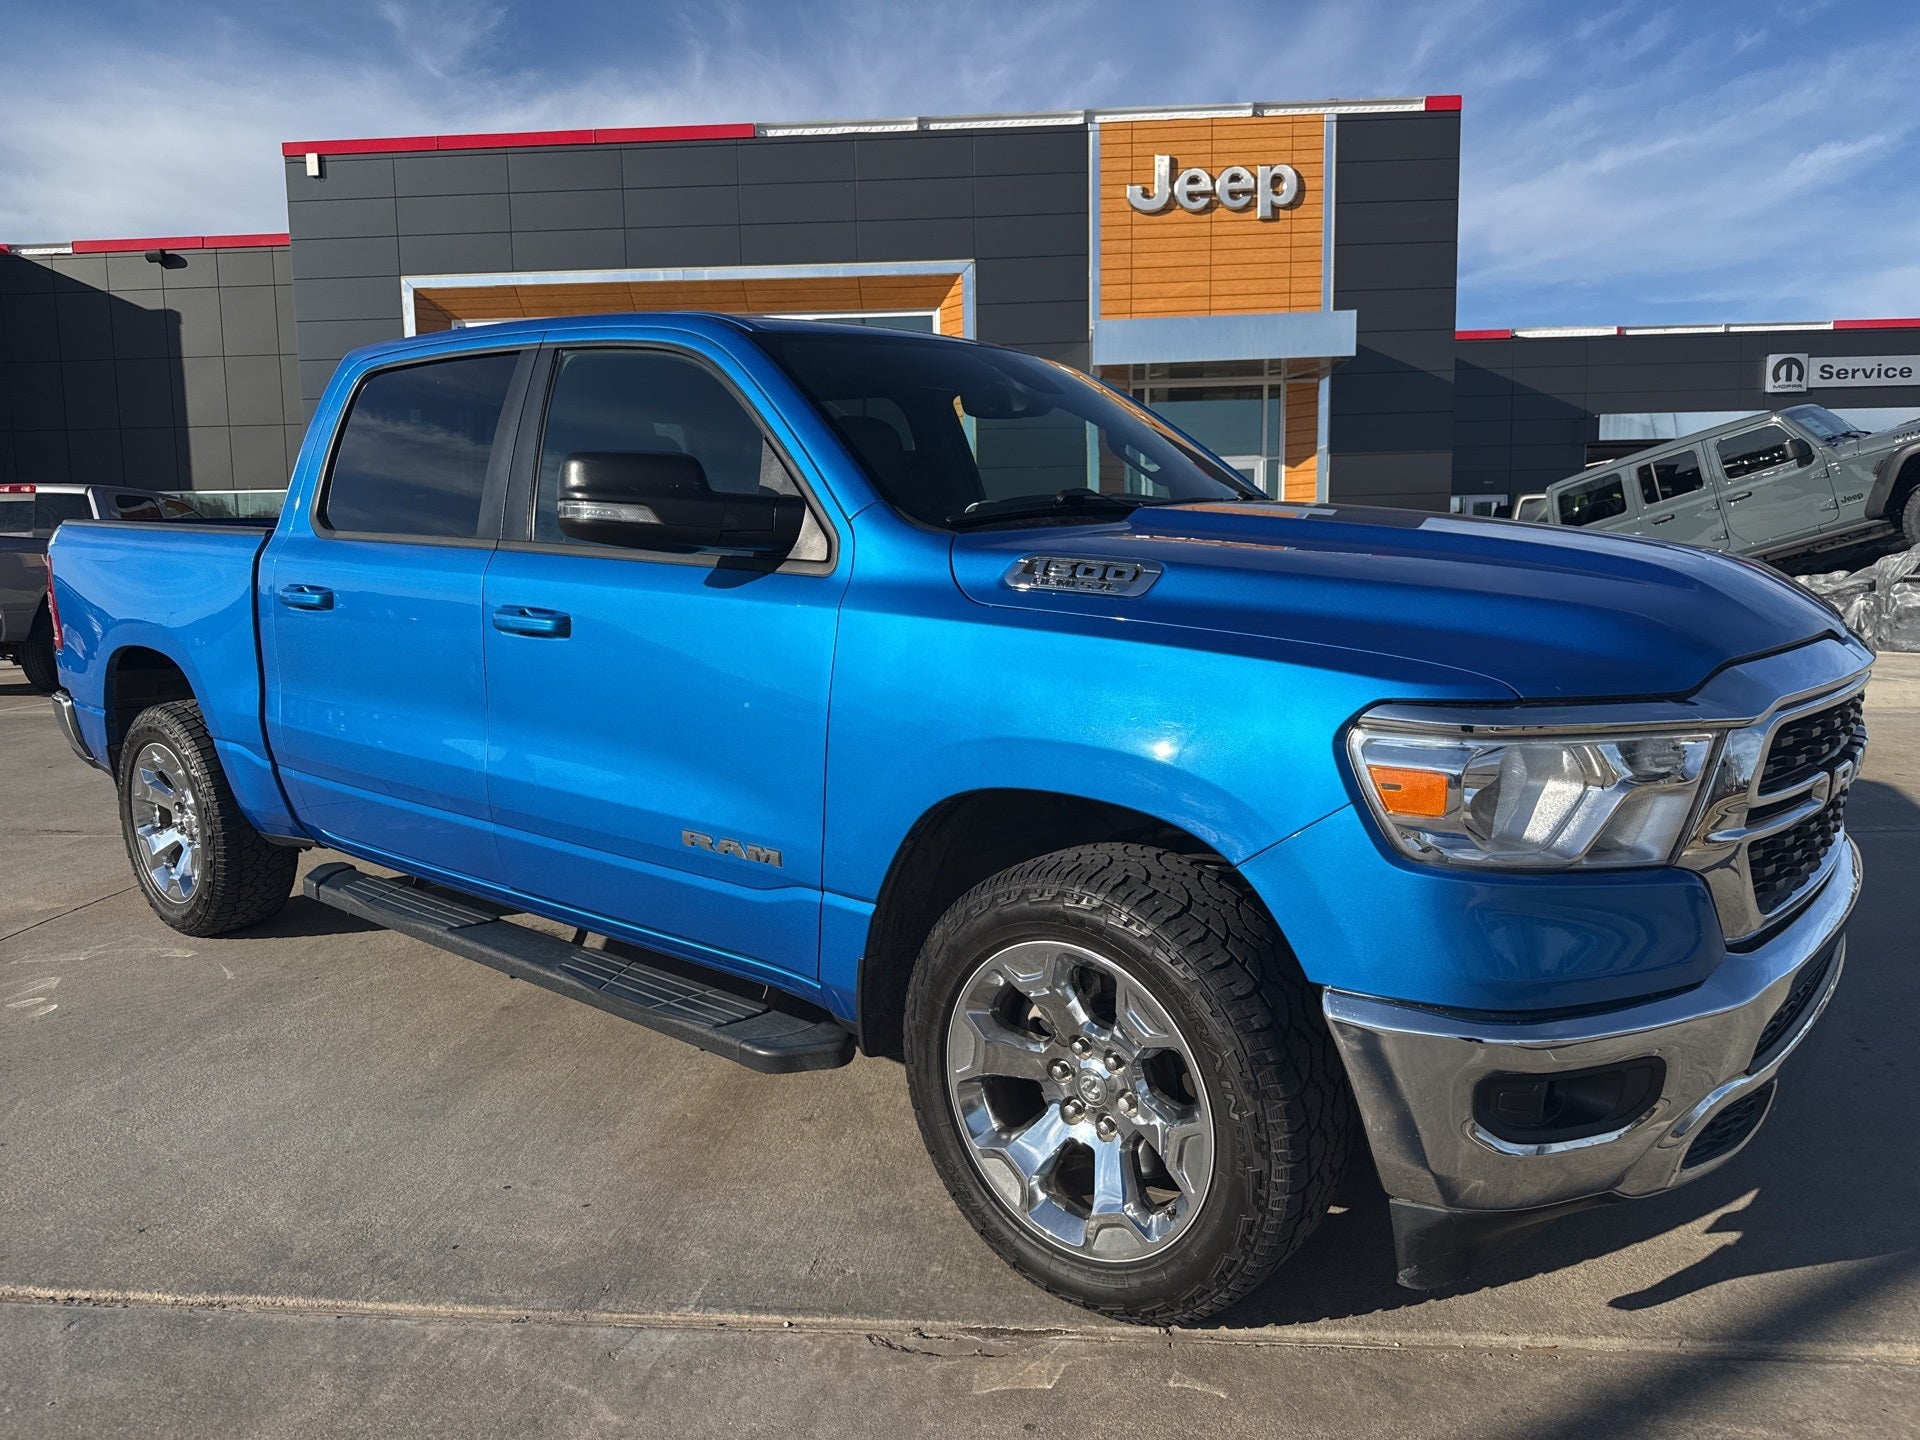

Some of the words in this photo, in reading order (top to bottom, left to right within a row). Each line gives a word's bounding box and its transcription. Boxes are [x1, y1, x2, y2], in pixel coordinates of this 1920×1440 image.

[1126, 154, 1299, 219] Jeep
[1819, 363, 1913, 381] Service
[1841, 492, 1864, 504] Jeep
[1035, 559, 1137, 582] 1500
[682, 829, 783, 868] RAM
